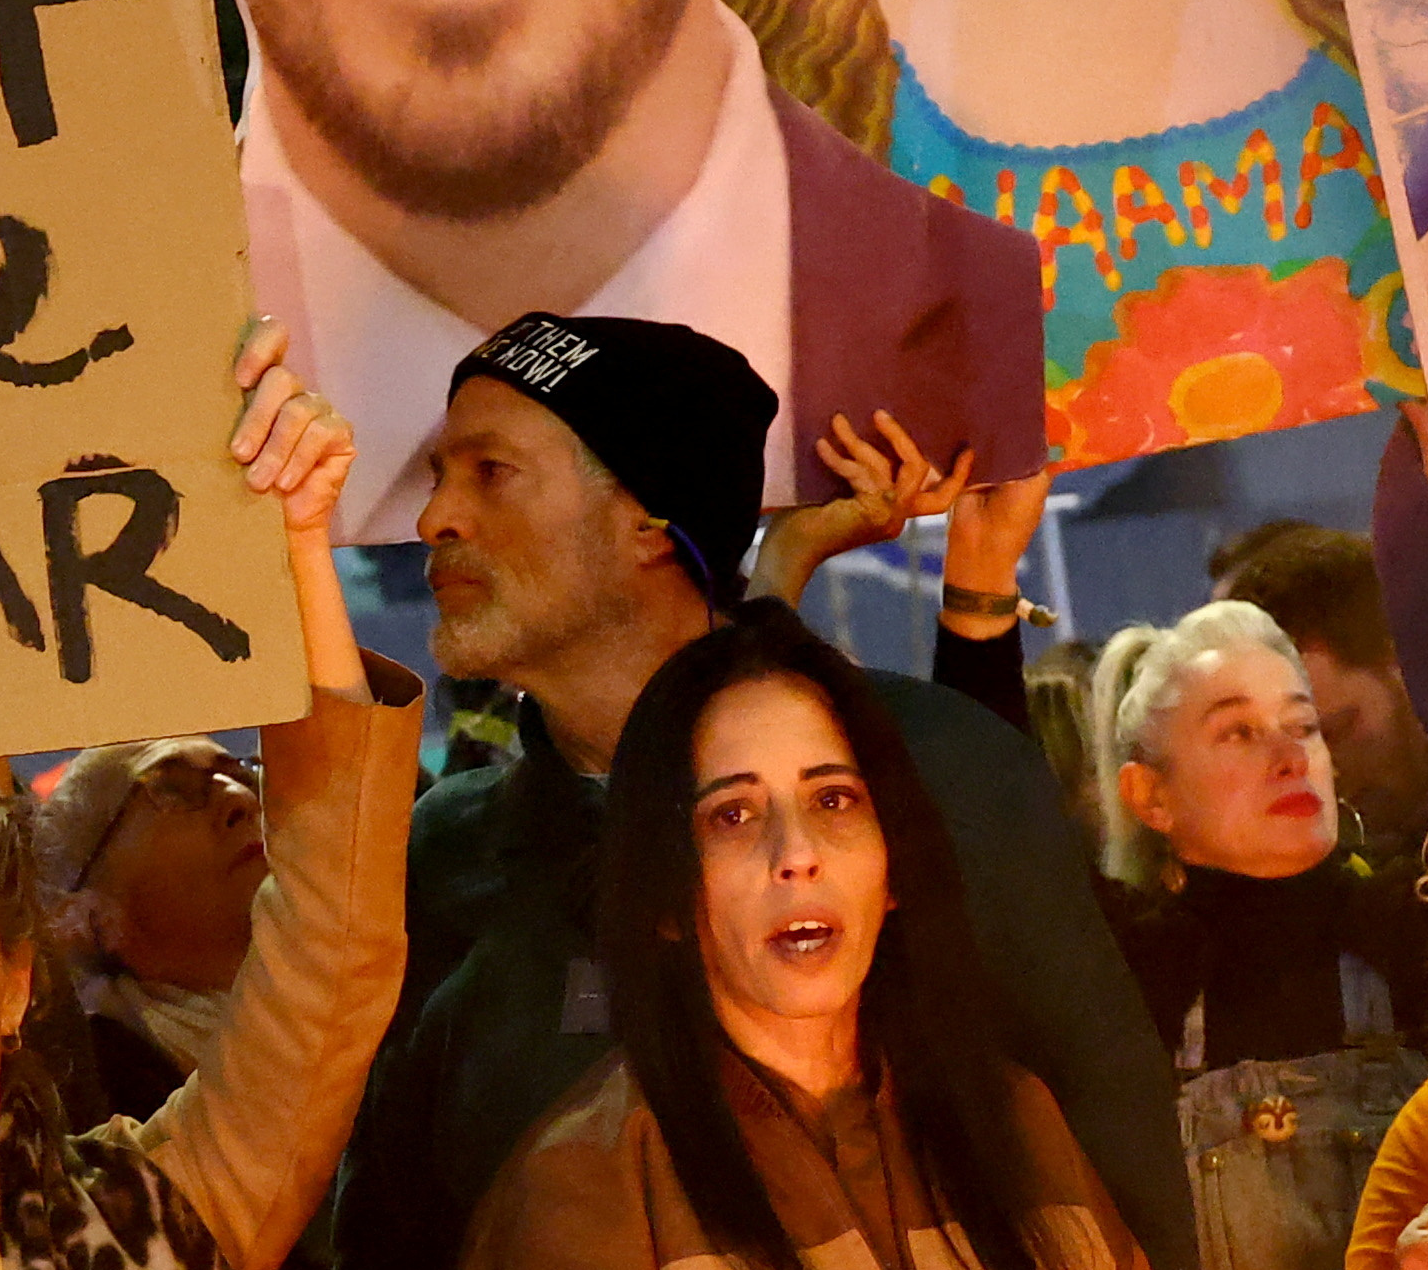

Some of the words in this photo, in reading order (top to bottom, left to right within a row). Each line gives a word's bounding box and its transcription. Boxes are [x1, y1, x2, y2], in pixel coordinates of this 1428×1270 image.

[928, 102, 1389, 312] AAMA
[494, 342, 569, 393] NOW!
[524, 321, 599, 369] THEM
